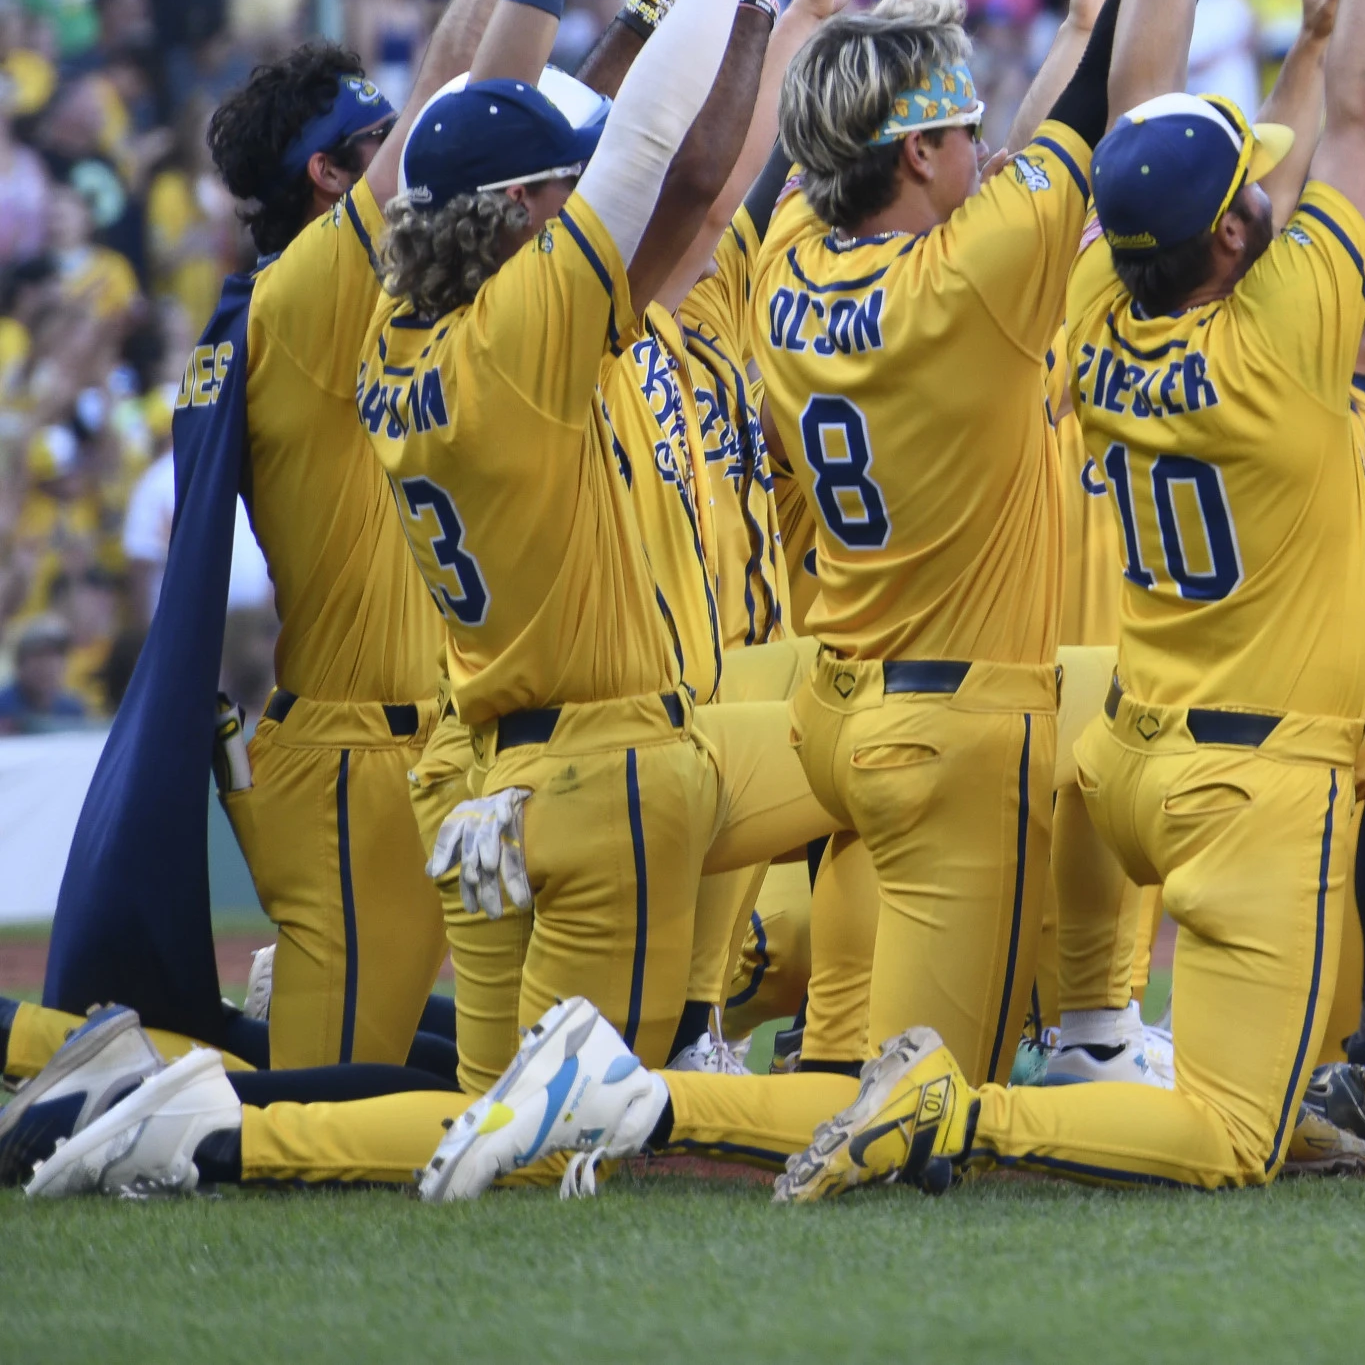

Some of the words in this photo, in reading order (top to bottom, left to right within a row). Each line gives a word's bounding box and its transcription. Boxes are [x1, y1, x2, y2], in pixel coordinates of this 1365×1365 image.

[400, 473, 493, 628] 3
[797, 391, 893, 552] 8
[1104, 441, 1246, 604] 10
